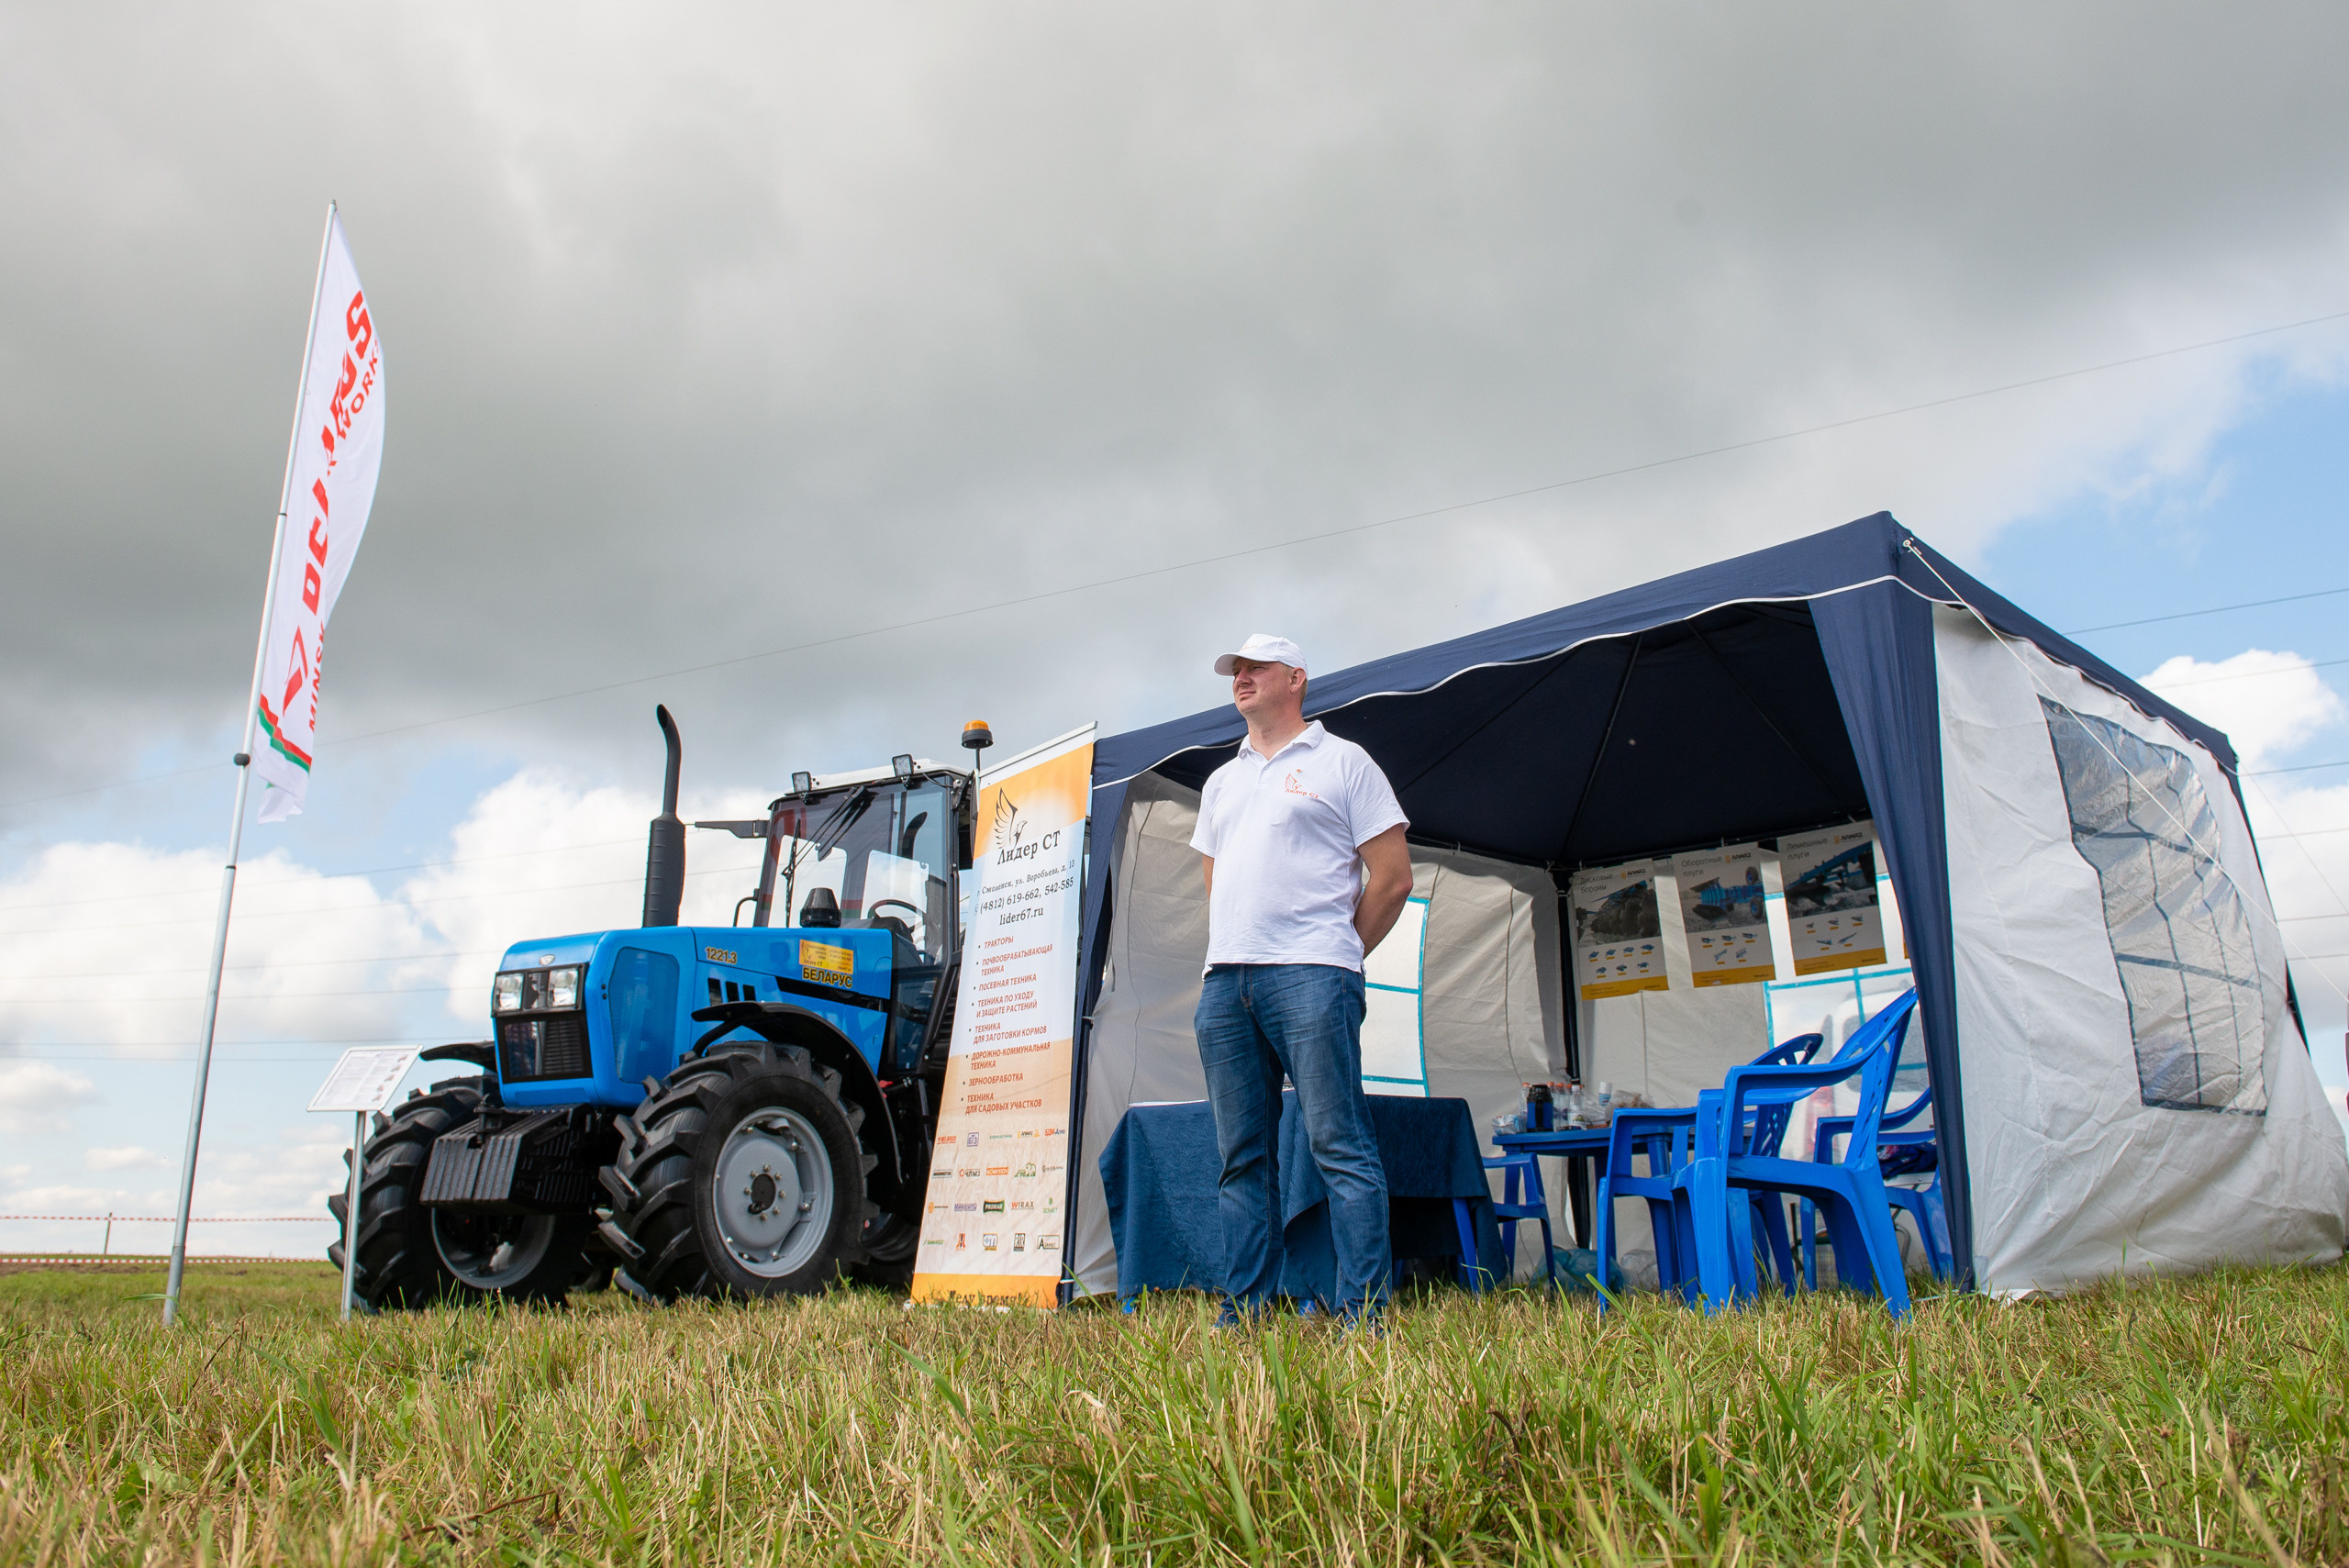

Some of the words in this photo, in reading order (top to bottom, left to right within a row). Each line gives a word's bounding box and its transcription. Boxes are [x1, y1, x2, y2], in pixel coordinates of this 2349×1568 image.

[997, 841, 1038, 865] Лидер
[1042, 829, 1061, 850] СТ
[1681, 856, 1722, 867] Оборотные
[982, 881, 1014, 895] Смоленск,
[1015, 878, 1024, 887] ул.
[1027, 869, 1060, 883] Воробьева,
[1069, 860, 1075, 870] 13
[1580, 873, 1613, 884] Дисковые
[980, 896, 1005, 915] (4812)
[1007, 888, 1041, 906] 619-662,
[1044, 877, 1074, 895] 542-585
[999, 907, 1043, 926] lider67.ru
[984, 936, 1014, 949] ТРАКТОРЫ
[705, 947, 738, 964] 1221.3
[982, 944, 1052, 966] ПОЧВООБРАБАТЫВАЮЩАЯ
[802, 966, 853, 989] БЕЛАРУС
[981, 965, 1005, 976] ТЕХНИКА
[978, 979, 1009, 992] ПОСЕВНАЯ
[1010, 973, 1037, 985] ТЕХНИКА
[978, 996, 1003, 1007] ТЕХНИКА
[1004, 995, 1014, 1003] ПО
[1014, 991, 1034, 1002] УХОДУ
[982, 1006, 1006, 1018] ЗАЩИТЕ
[1006, 999, 1038, 1013] РАСТЕНИЙ
[973, 1036, 985, 1045] ДЛЯ
[985, 1030, 1021, 1042] ЗАГОТОВКИ
[1021, 1026, 1047, 1037] КОРМОВ
[974, 1022, 1001, 1033] ТЕХНИКА
[971, 1041, 1051, 1062] ДОРОЖНО-КОММУНАЛЬНАЯ
[971, 1060, 996, 1071] ТЕХНИКА
[968, 1073, 1023, 1086] ЗЕРНООБРАБОТКА
[967, 1093, 994, 1103] ТЕХНИКА
[965, 1106, 978, 1116] ДЛЯ
[978, 1102, 1009, 1114] САДОВЫХ
[1010, 1099, 1042, 1110] УЧАСТКОВ
